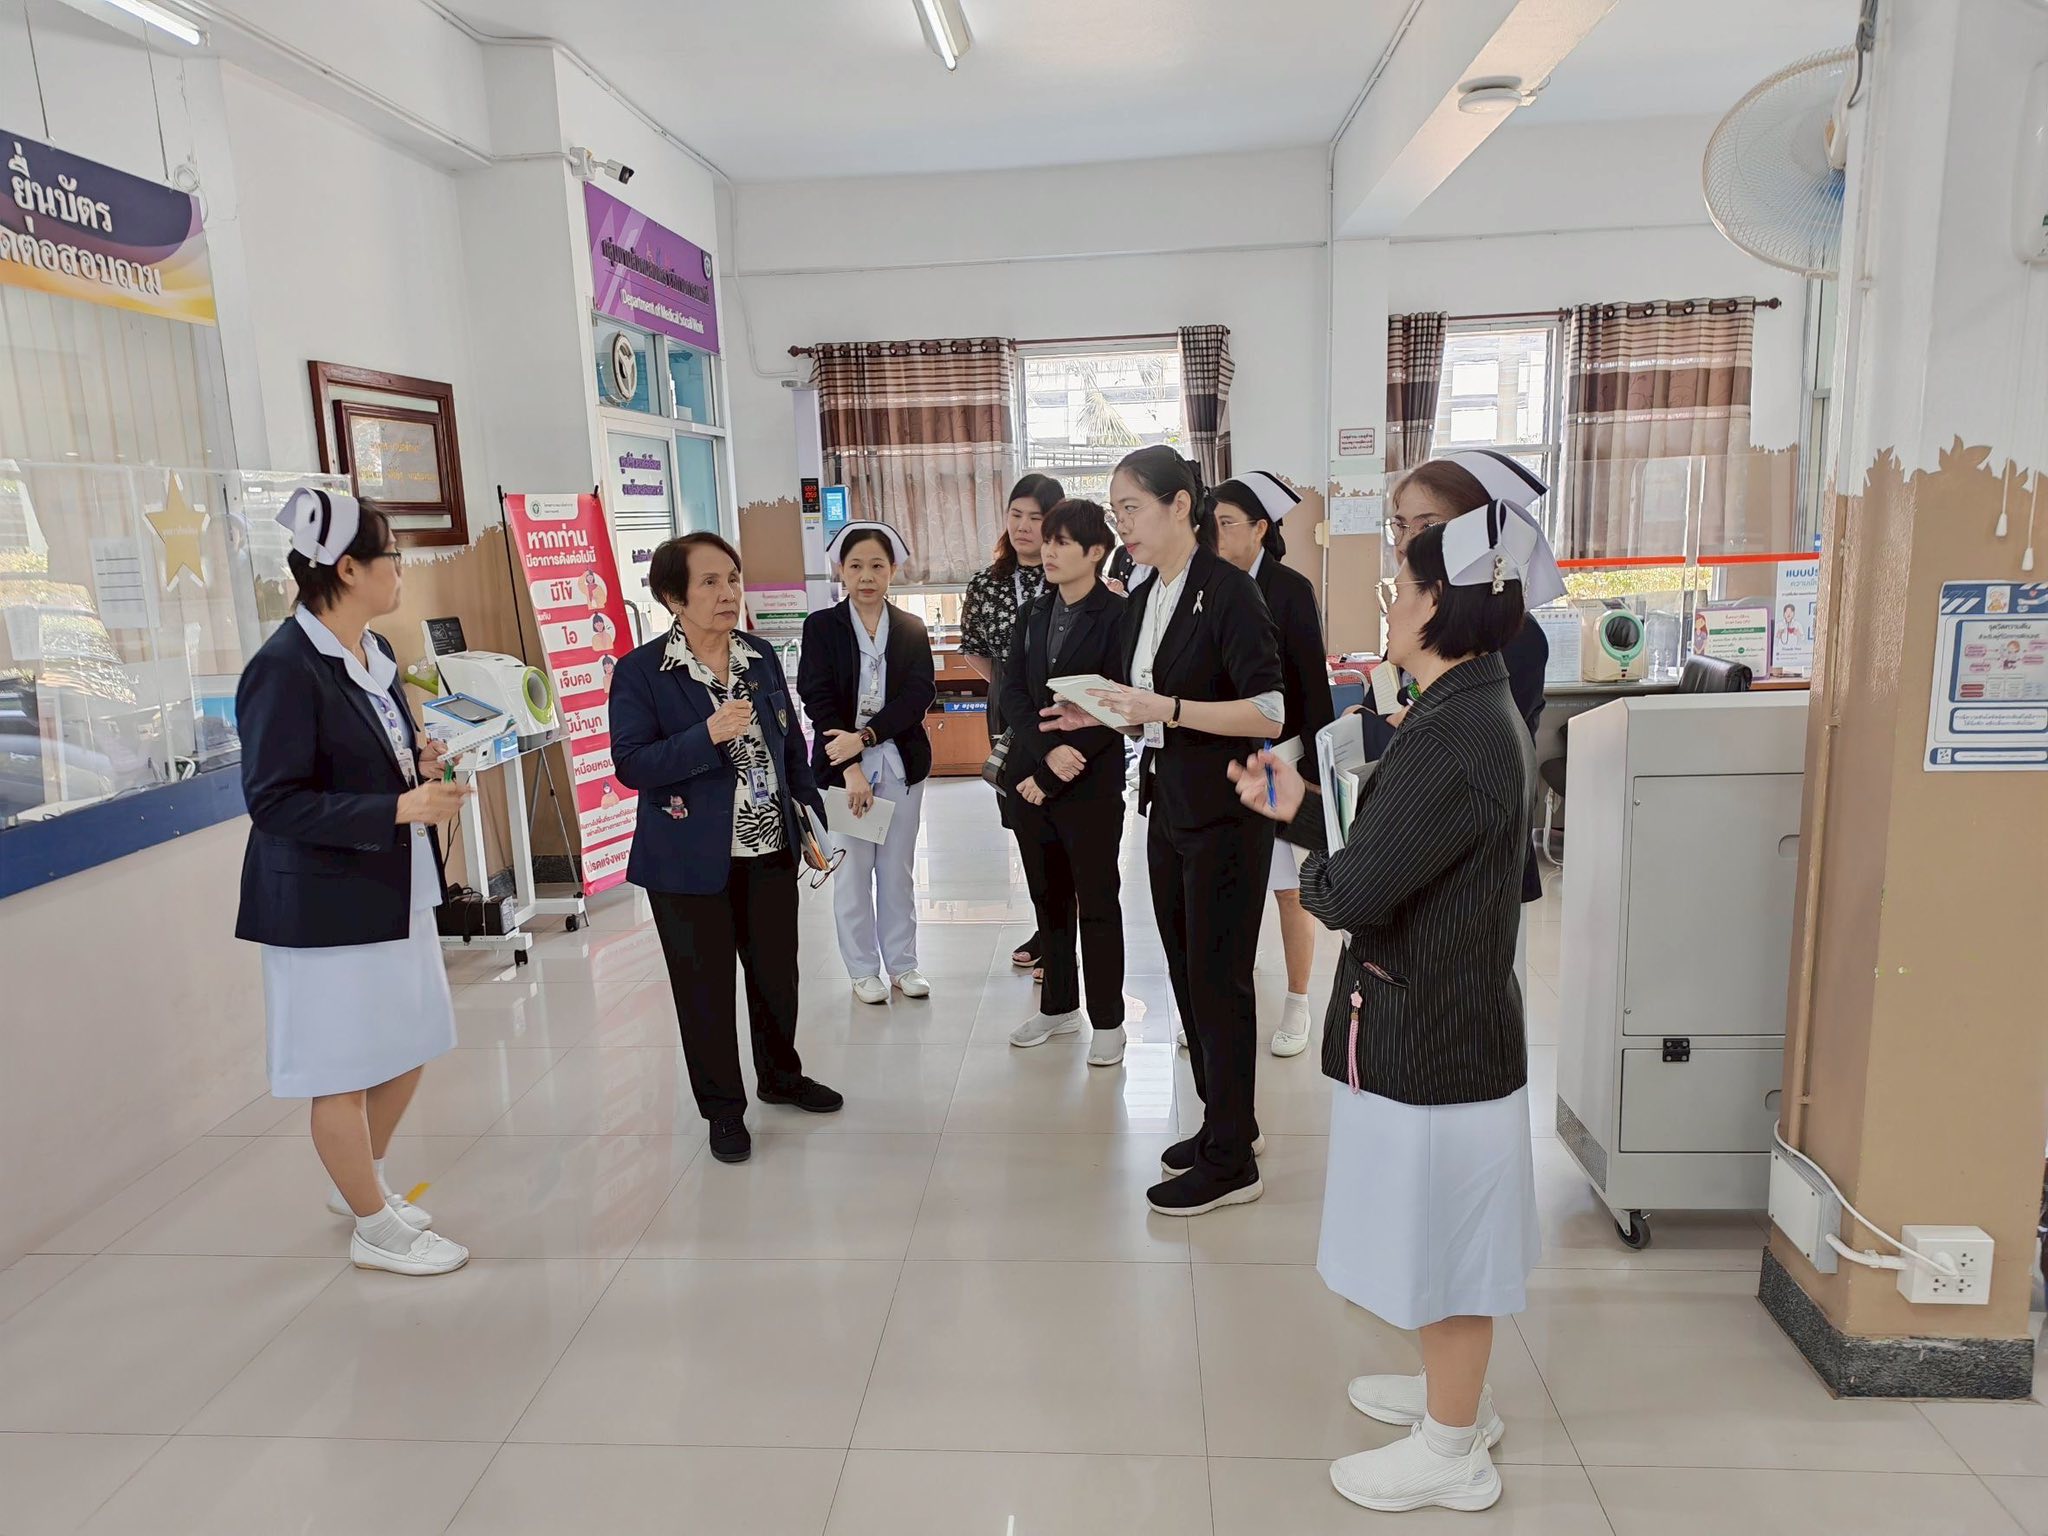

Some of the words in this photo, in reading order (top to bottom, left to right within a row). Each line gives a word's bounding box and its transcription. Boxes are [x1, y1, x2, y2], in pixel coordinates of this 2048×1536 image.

[8, 141, 113, 233] ยื่นบัตร
[621, 288, 654, 312] Department
[660, 304, 679, 324] Medical
[527, 523, 588, 550] หากท่าน
[525, 546, 597, 568] มีอาการดังต่อไปนี้
[550, 580, 573, 602] มีไข้
[562, 626, 578, 645] ไอ
[560, 671, 593, 689] เจ็บคอ
